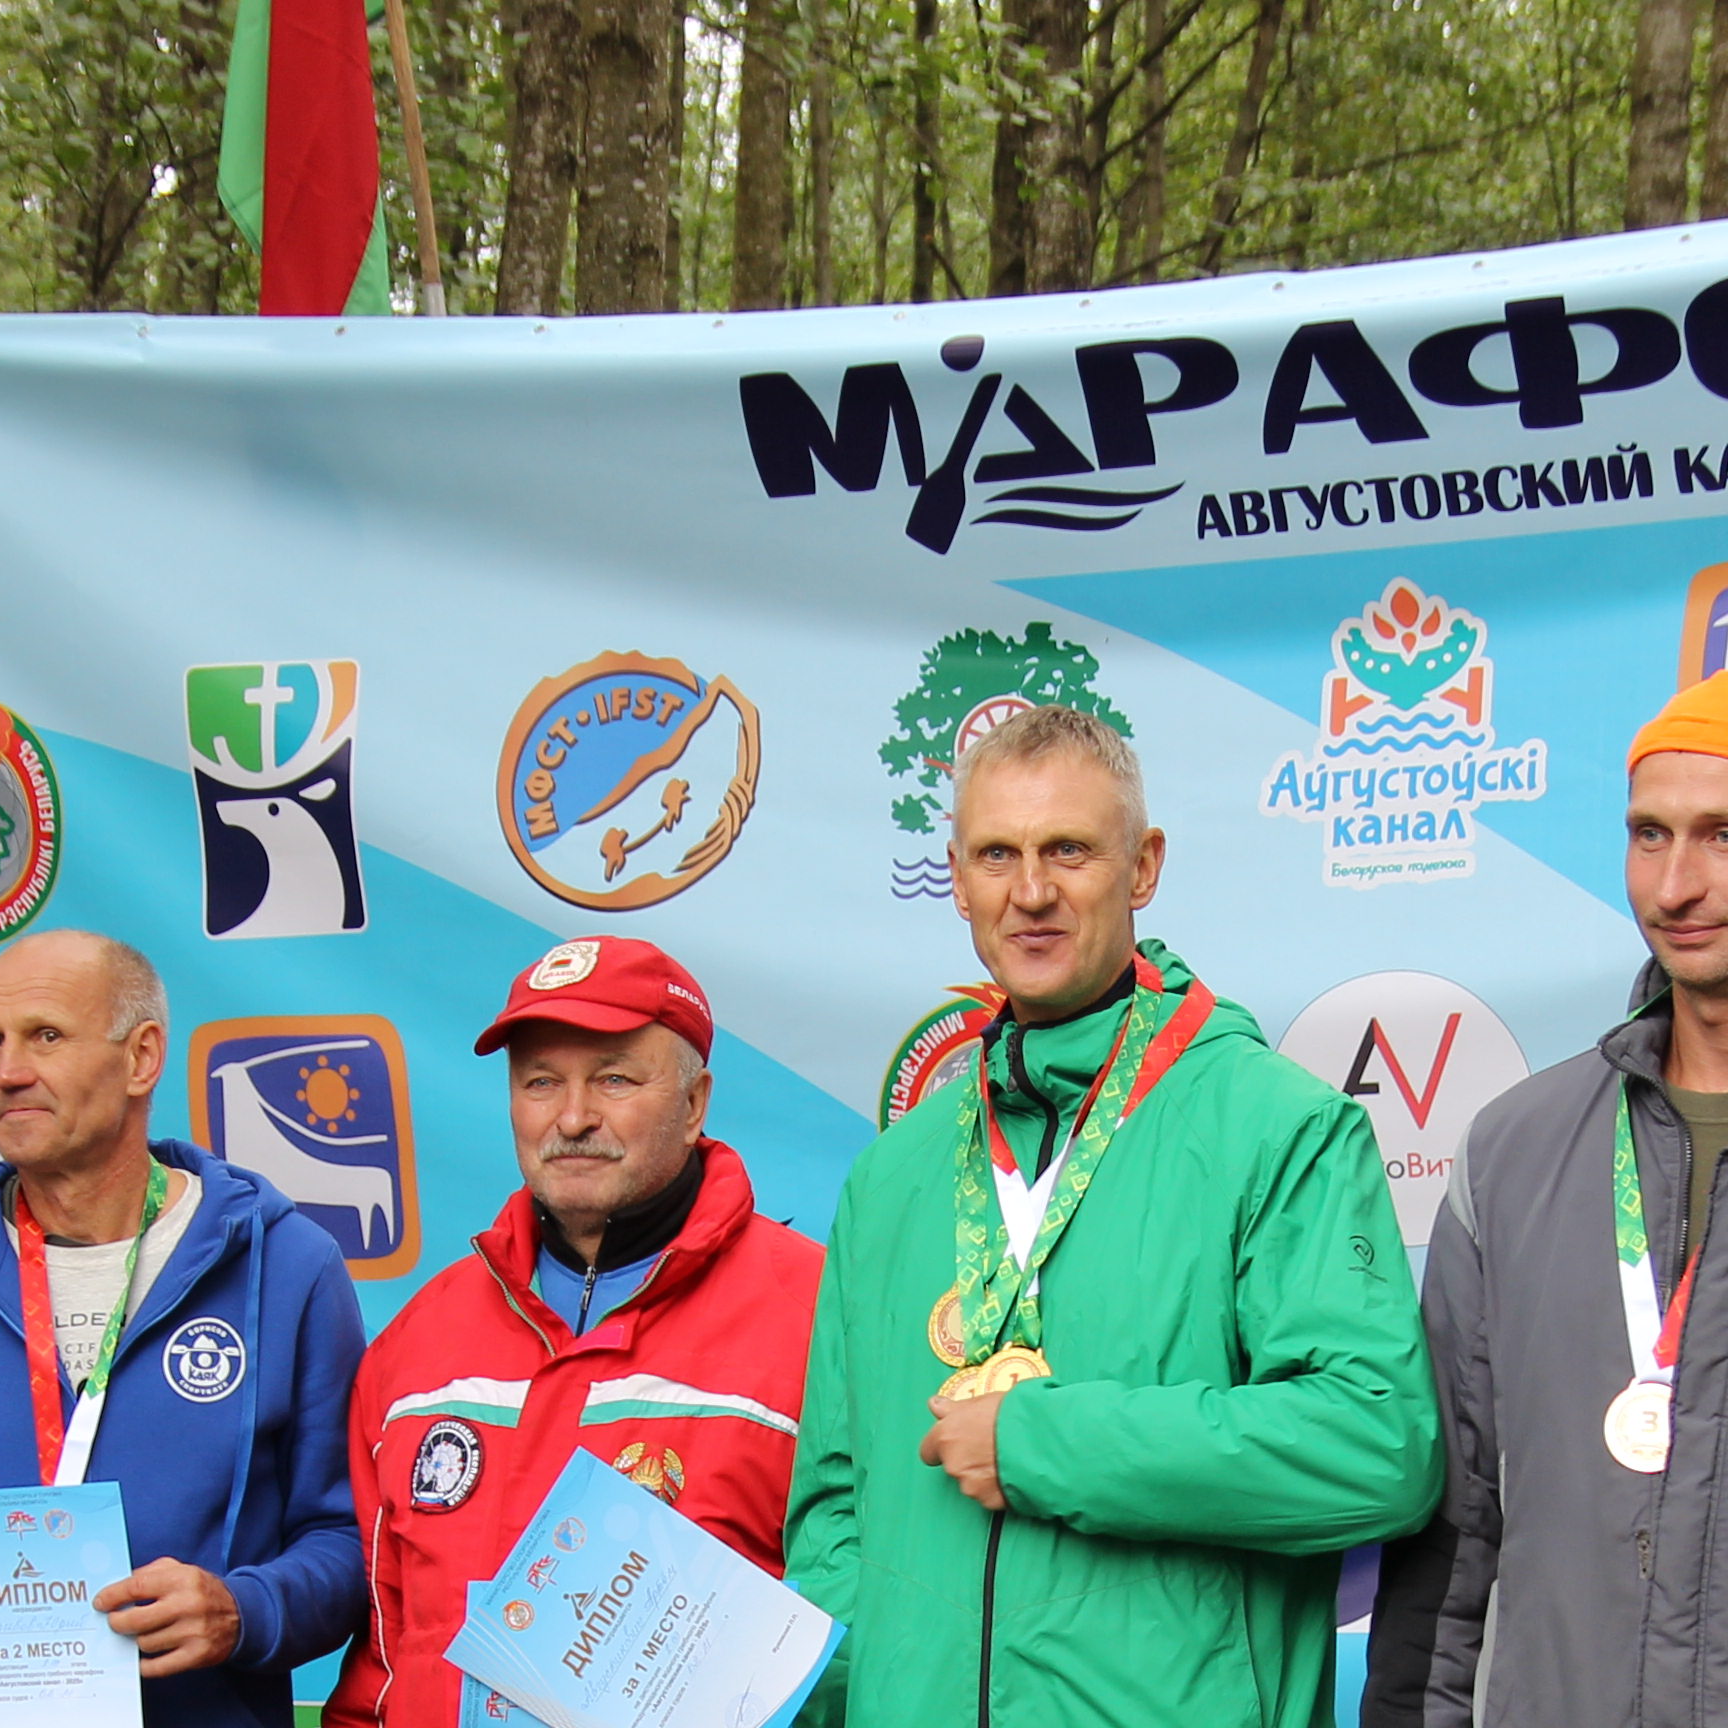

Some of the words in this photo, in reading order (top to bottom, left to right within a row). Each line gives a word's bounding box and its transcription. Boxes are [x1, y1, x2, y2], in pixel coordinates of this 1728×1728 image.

[1195, 440, 1654, 542] АВГУСТОВСКИЙ
[592, 687, 685, 728] IFST
[18, 739, 56, 833] БЕЛАРУСЬ
[1268, 748, 1539, 813] Аўгустоўскі
[1332, 808, 1467, 848] канал
[887, 1010, 967, 1127] МІНІСТЭРСТВ
[12, 1644, 22, 1659] 2
[25, 1639, 86, 1658] МЕСТО
[561, 1550, 650, 1679] ДИПЛОМ
[622, 1674, 641, 1699] за
[635, 1662, 648, 1675] 1
[642, 1594, 688, 1661] МЕСТО
